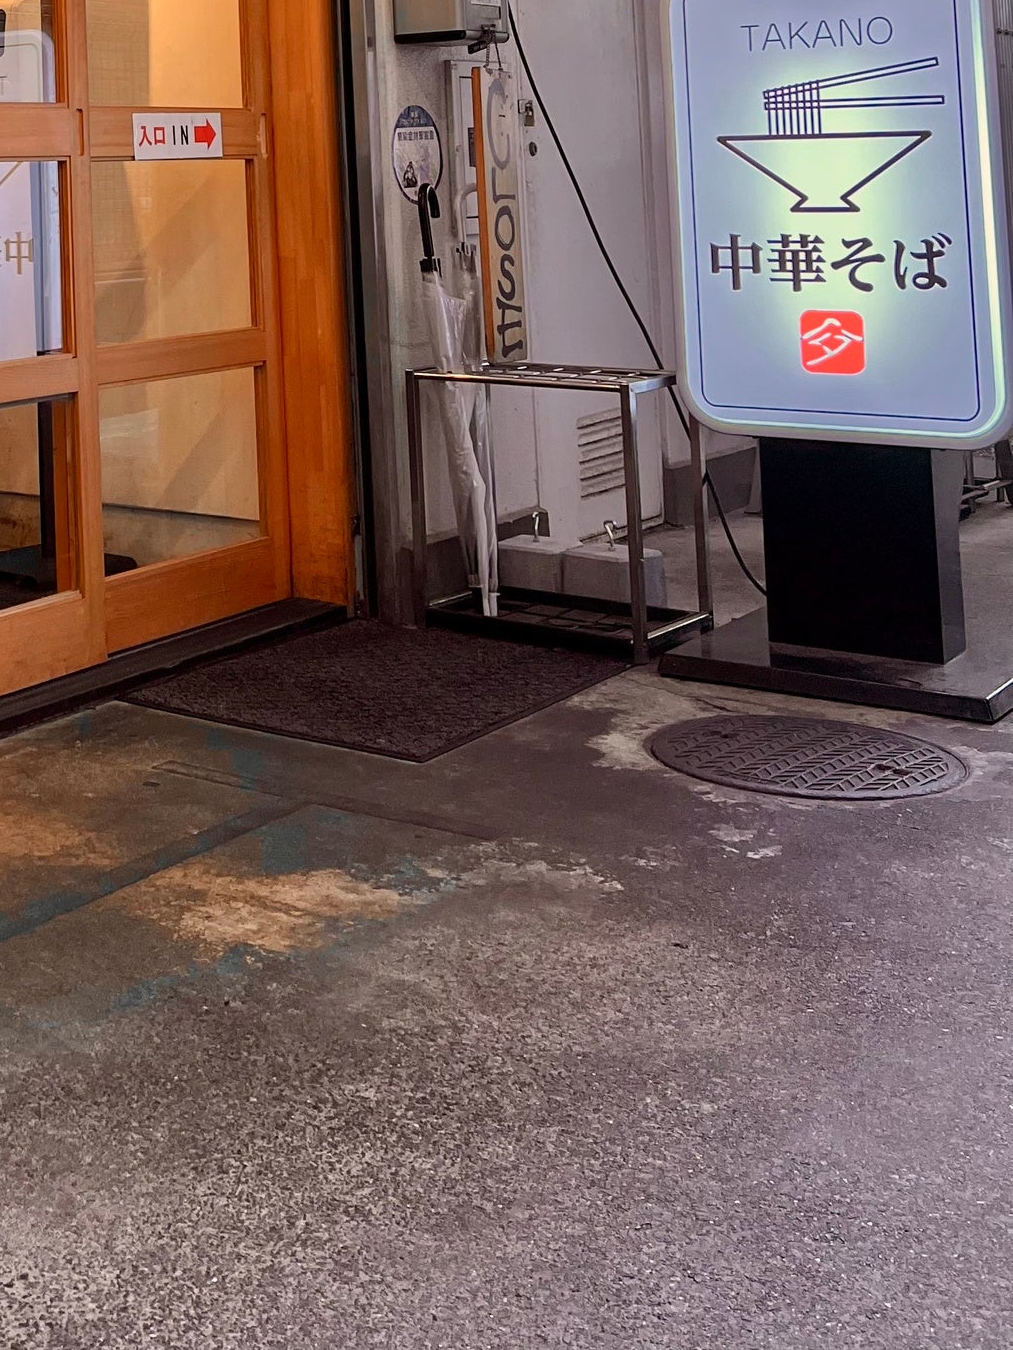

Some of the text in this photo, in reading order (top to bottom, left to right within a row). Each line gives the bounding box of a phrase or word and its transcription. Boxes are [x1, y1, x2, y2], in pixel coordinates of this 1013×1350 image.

[740, 15, 894, 53] TAKANO
[138, 124, 189, 147] 入口 IN
[709, 231, 953, 293] 中華そば
